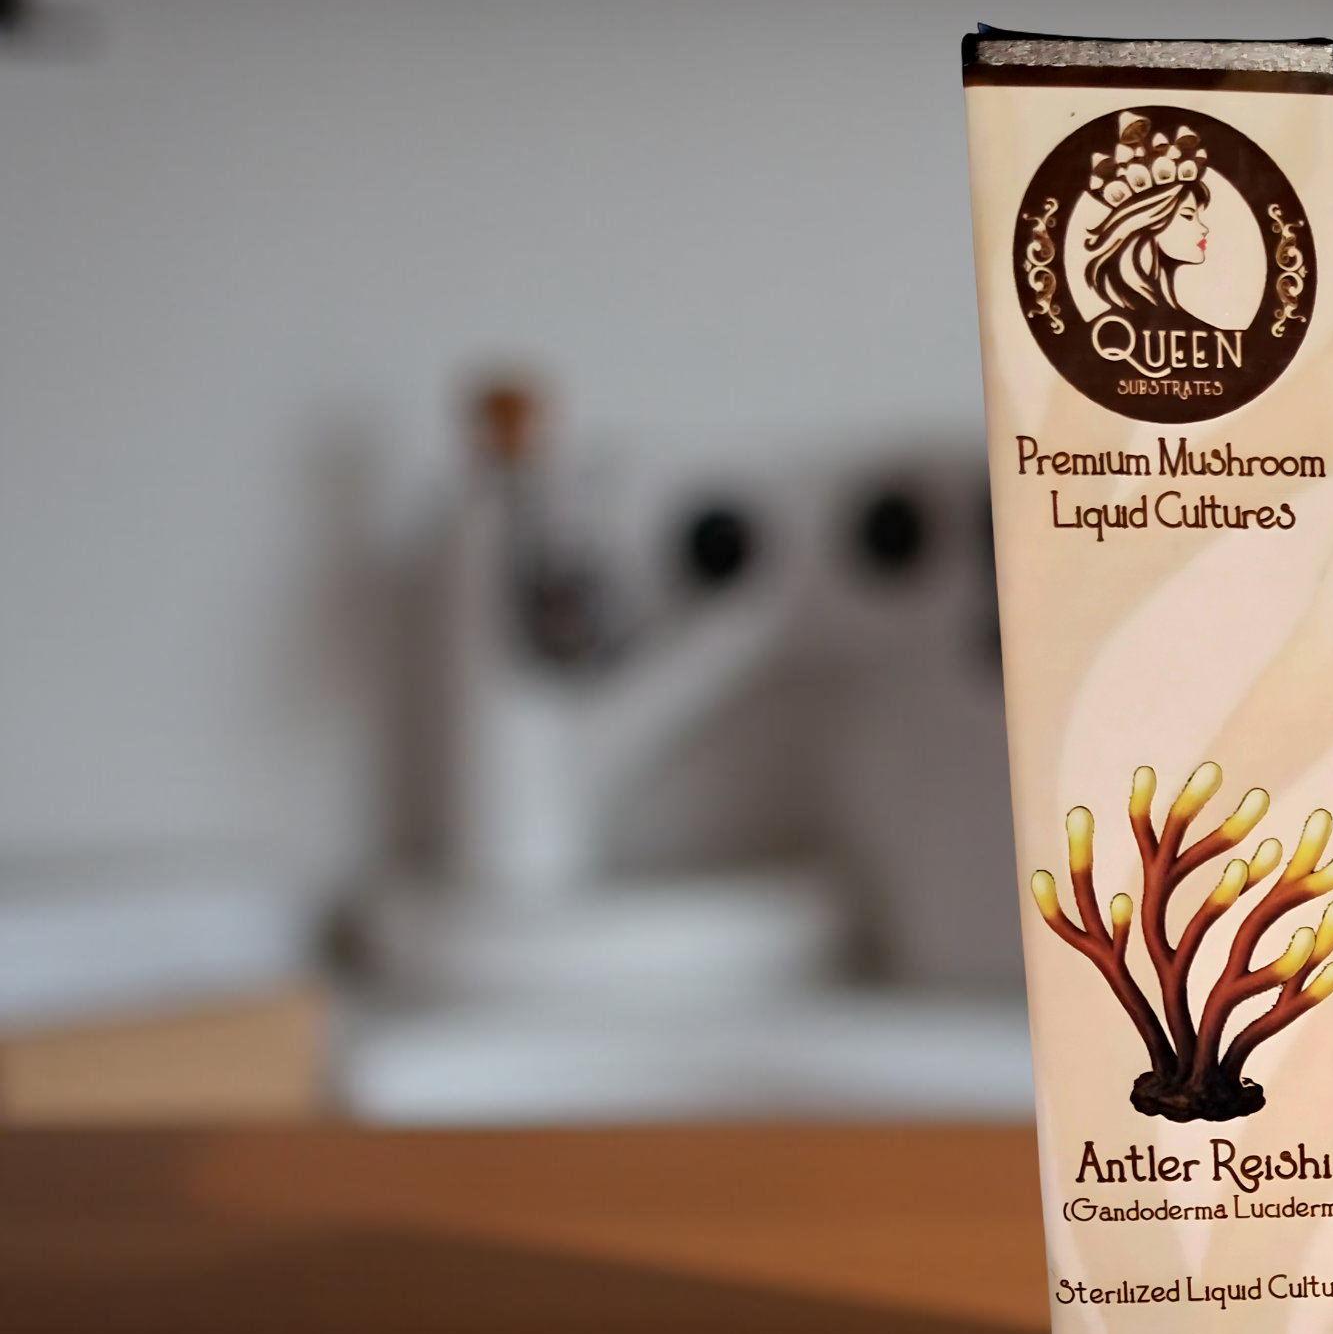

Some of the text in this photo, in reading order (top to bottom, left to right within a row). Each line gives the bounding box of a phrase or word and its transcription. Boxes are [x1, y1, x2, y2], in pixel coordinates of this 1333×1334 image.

[1092, 315, 1242, 378] QUEEN
[1117, 380, 1224, 400] SUBSTRATES
[1015, 435, 1327, 478] Premium Mushroom
[1050, 489, 1296, 543] Liquid Cultures
[1075, 1138, 1333, 1194] Antler Reishi
[1062, 1197, 1229, 1222] (Gandoderma
[1055, 1279, 1180, 1305] Sterilized
[1186, 1276, 1262, 1310] Liquid
